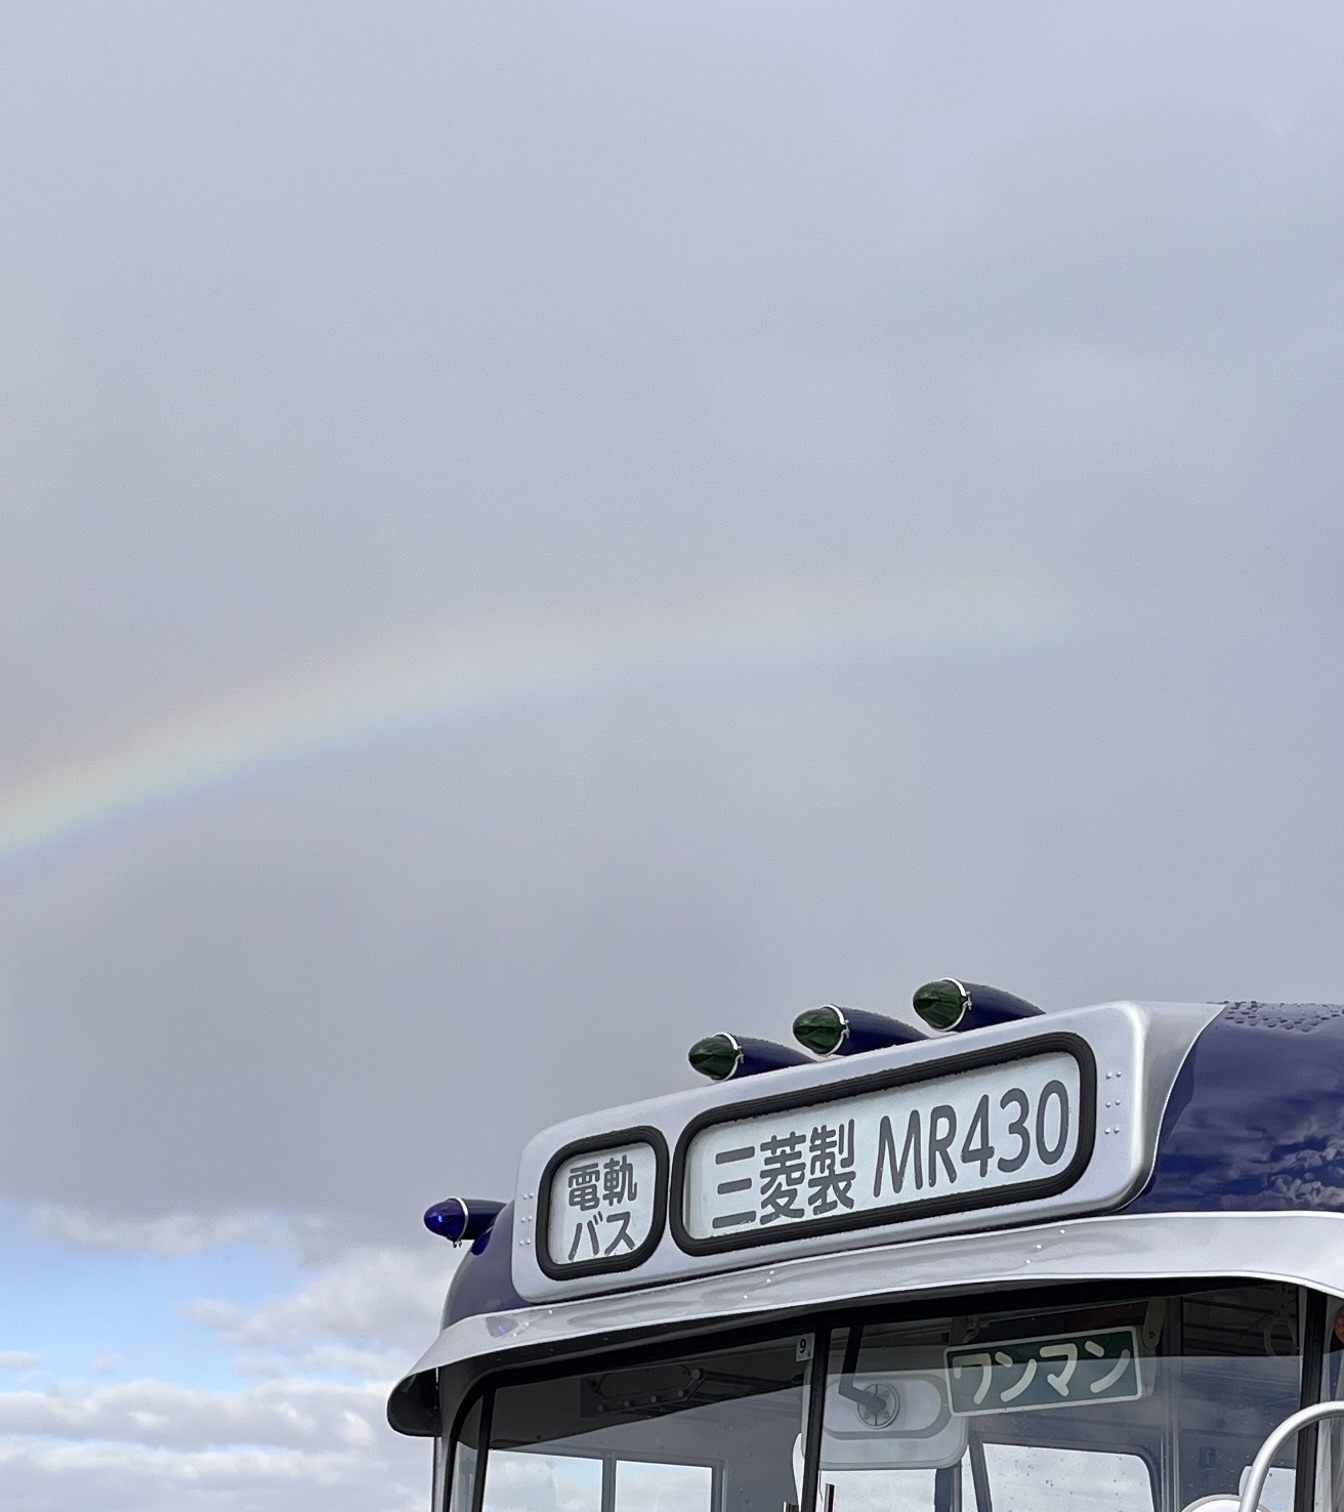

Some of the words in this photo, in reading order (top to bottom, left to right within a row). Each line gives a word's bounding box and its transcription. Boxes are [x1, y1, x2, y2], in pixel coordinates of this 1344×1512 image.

[568, 1155, 637, 1212] 電軌
[712, 1118, 856, 1230] 三菱製
[873, 1079, 1069, 1198] MR430
[568, 1211, 636, 1261] バス
[952, 1340, 1131, 1405] ワンマン
